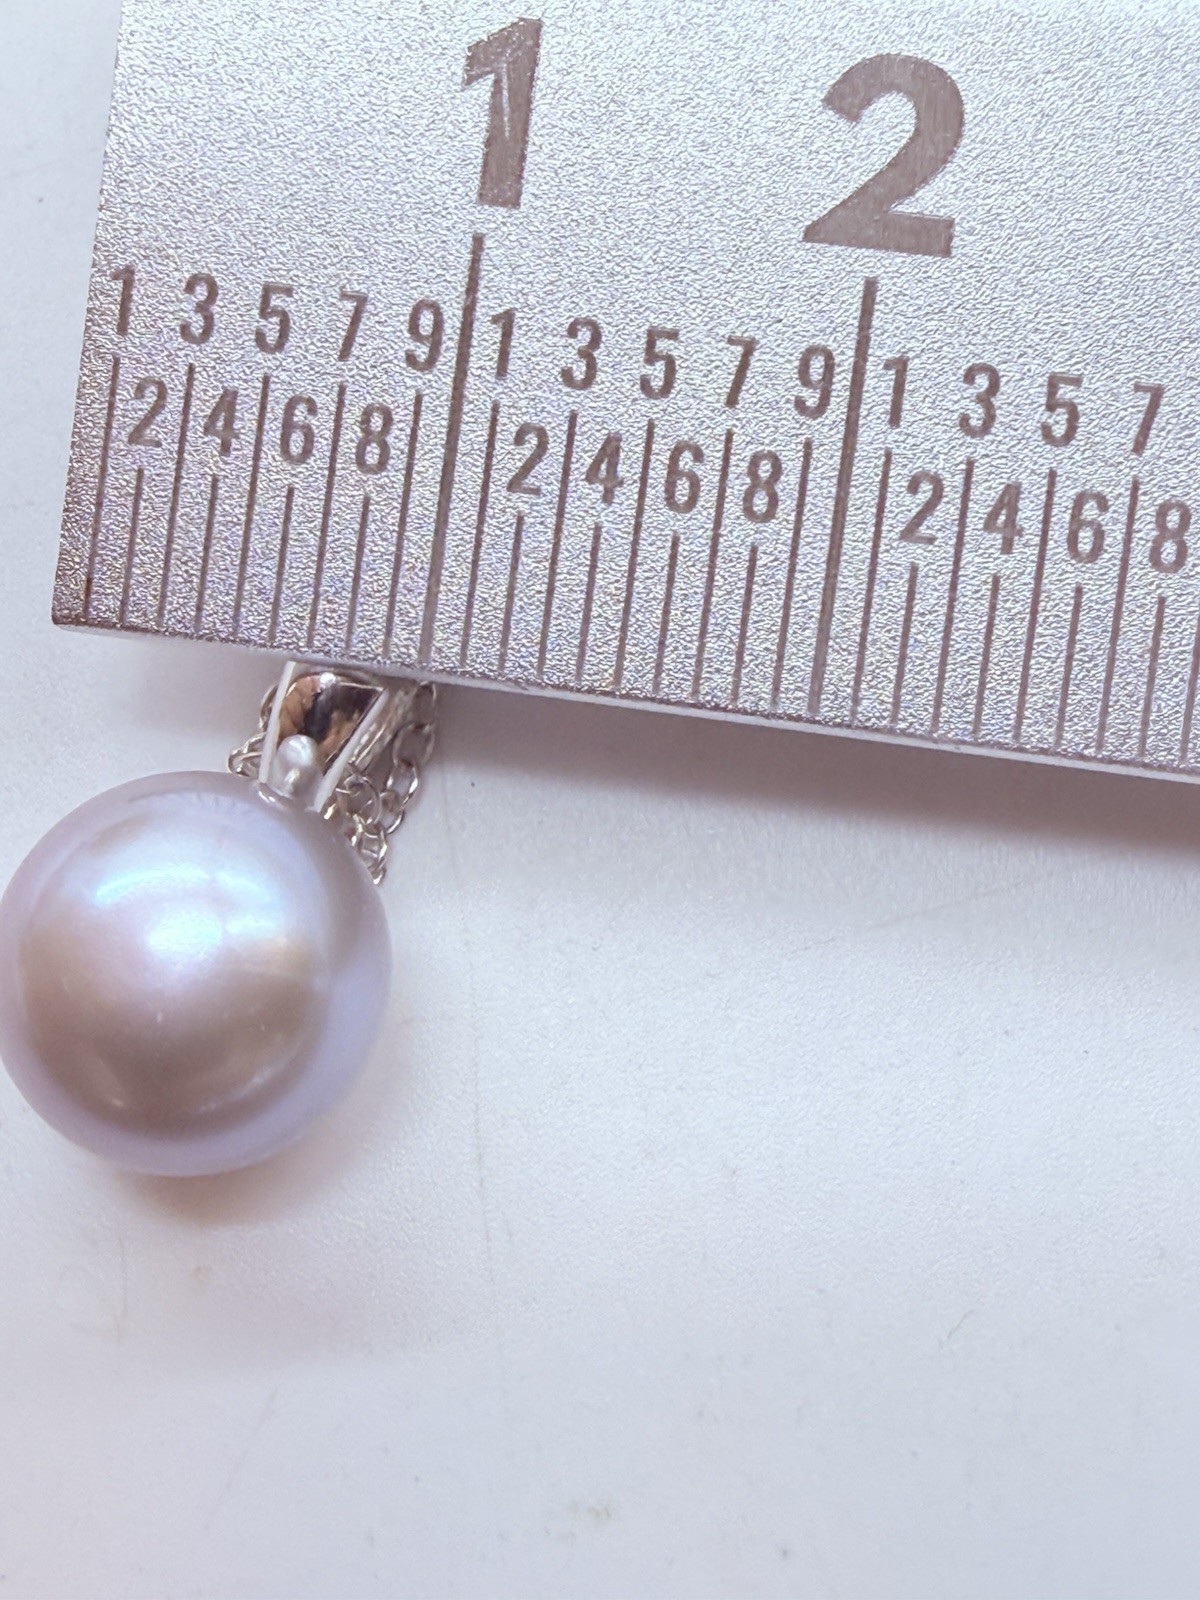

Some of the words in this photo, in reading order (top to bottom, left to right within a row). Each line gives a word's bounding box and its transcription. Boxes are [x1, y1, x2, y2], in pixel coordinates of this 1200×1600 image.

[461, 17, 543, 210] 1
[803, 52, 965, 258] 2
[110, 264, 136, 337] 1
[179, 272, 219, 346] 3
[254, 282, 294, 354] 5
[337, 288, 369, 362] 7
[404, 299, 445, 373] 9
[490, 308, 517, 381] 1
[560, 317, 602, 390] 3
[639, 325, 680, 400] 5
[724, 335, 759, 410] 7
[794, 345, 837, 420] 9
[883, 352, 910, 429] 1
[958, 363, 1002, 439] 3
[1039, 372, 1083, 448] 5
[1132, 382, 1165, 457] 7
[127, 376, 167, 447] 2
[203, 388, 239, 456] 4
[280, 395, 318, 465] 6
[355, 404, 394, 474] 8
[506, 422, 549, 497] 2
[584, 432, 624, 506] 4
[664, 438, 703, 513] 6
[742, 450, 783, 523] 8
[899, 470, 944, 545] 2
[983, 481, 1024, 555] 4
[1066, 490, 1110, 563] 6
[1149, 500, 1192, 573] 8
